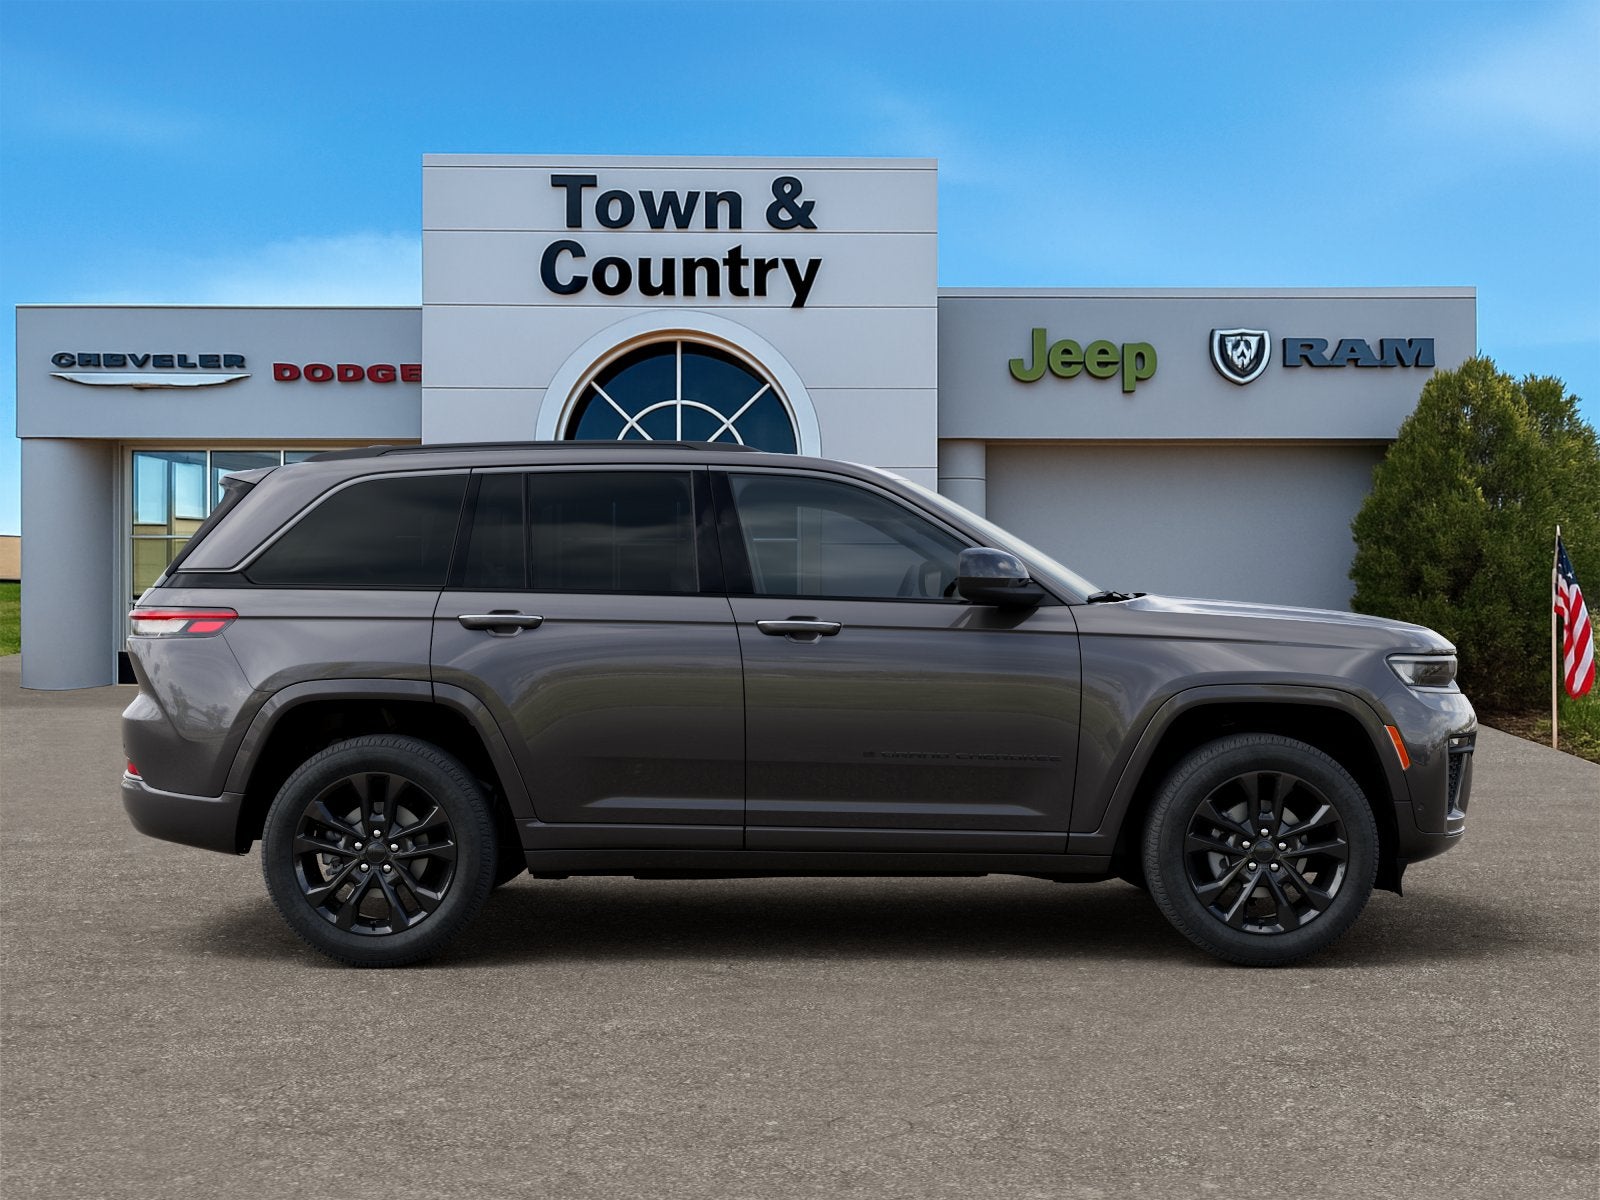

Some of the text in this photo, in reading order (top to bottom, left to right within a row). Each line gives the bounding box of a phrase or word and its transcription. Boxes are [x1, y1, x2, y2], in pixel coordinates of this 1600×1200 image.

[550, 174, 818, 230] Town &
[540, 239, 822, 308] Country
[273, 363, 422, 383] DODGE
[1009, 328, 1158, 393] Jeep
[1283, 338, 1435, 367] RAM
